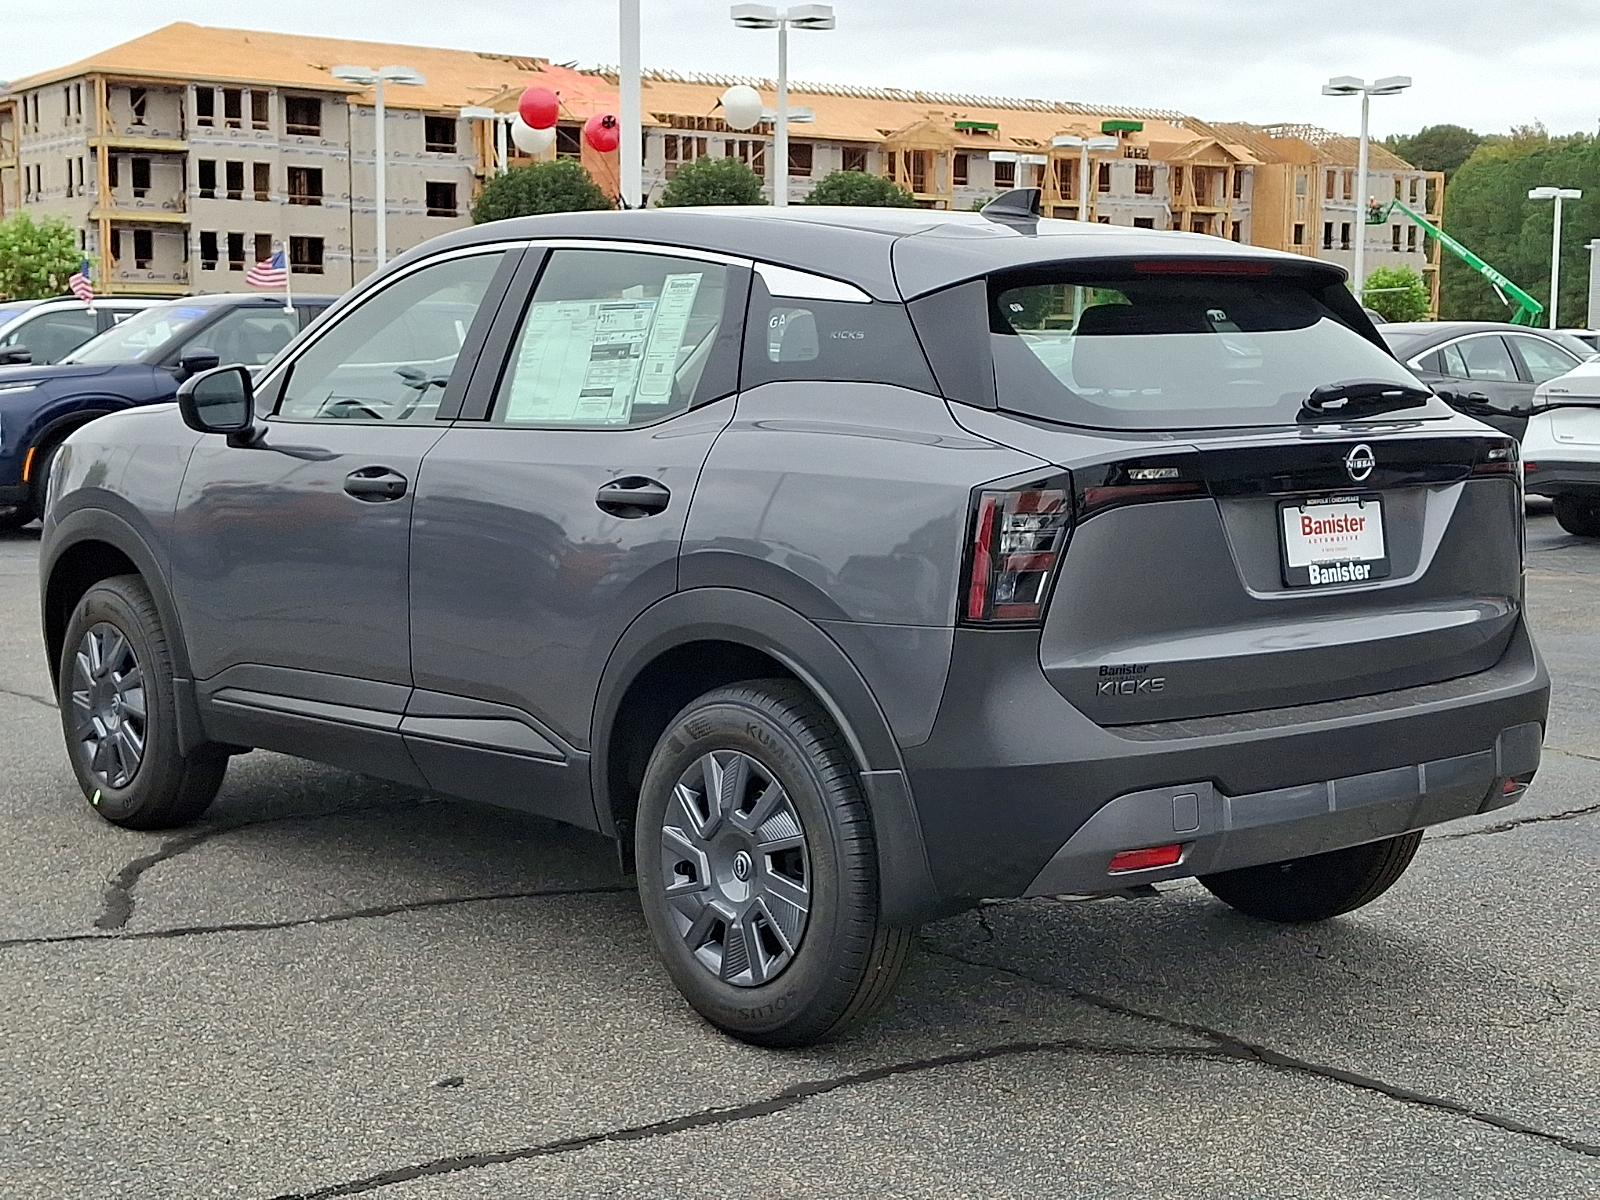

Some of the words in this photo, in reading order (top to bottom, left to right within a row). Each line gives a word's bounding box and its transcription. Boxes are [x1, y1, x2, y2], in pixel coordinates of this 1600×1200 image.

[830, 330, 865, 339] KICKS
[1346, 457, 1375, 468] NISSAN
[1301, 513, 1365, 536] Banister
[1308, 535, 1358, 544] AUTOMOTIVE
[1308, 562, 1371, 585] Banister
[1099, 664, 1149, 676] Banister
[1096, 678, 1165, 696] KICKS
